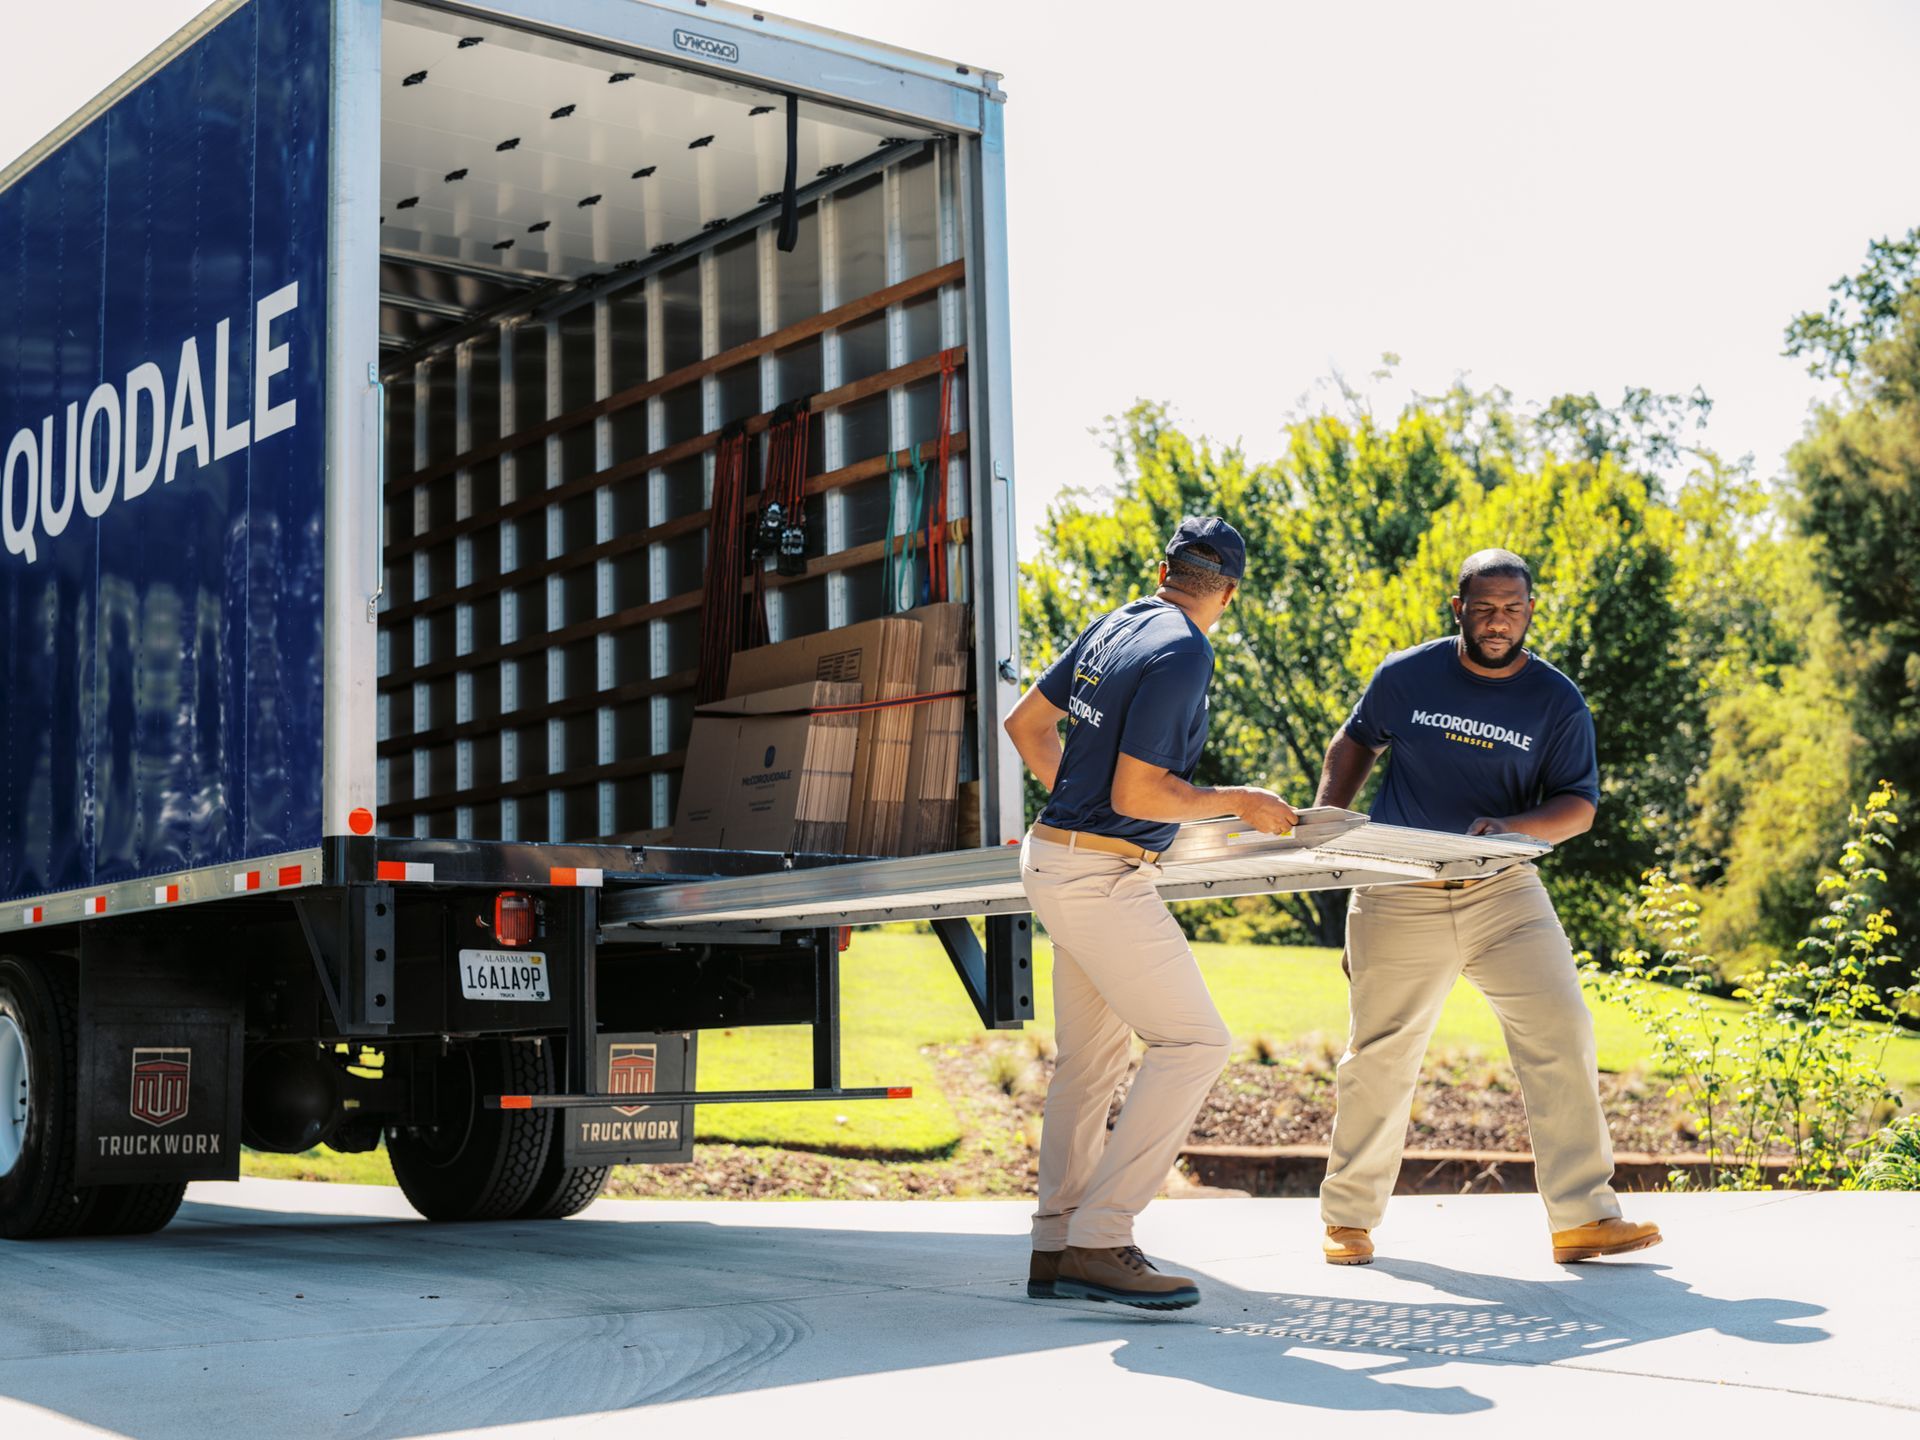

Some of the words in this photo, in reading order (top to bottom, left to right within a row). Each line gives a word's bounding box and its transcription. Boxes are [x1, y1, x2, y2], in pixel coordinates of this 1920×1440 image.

[677, 33, 735, 59] LYNCOACH
[2, 280, 298, 564] QUODALE
[1411, 709, 1532, 751] McCORQUODALE
[1445, 732, 1494, 749] TRANSFER
[484, 954, 524, 964] ALABAMA
[467, 965, 541, 990] 16A1A9P
[581, 1120, 679, 1141] TRUCKWORX
[98, 1134, 220, 1156] TRUCKWORX
